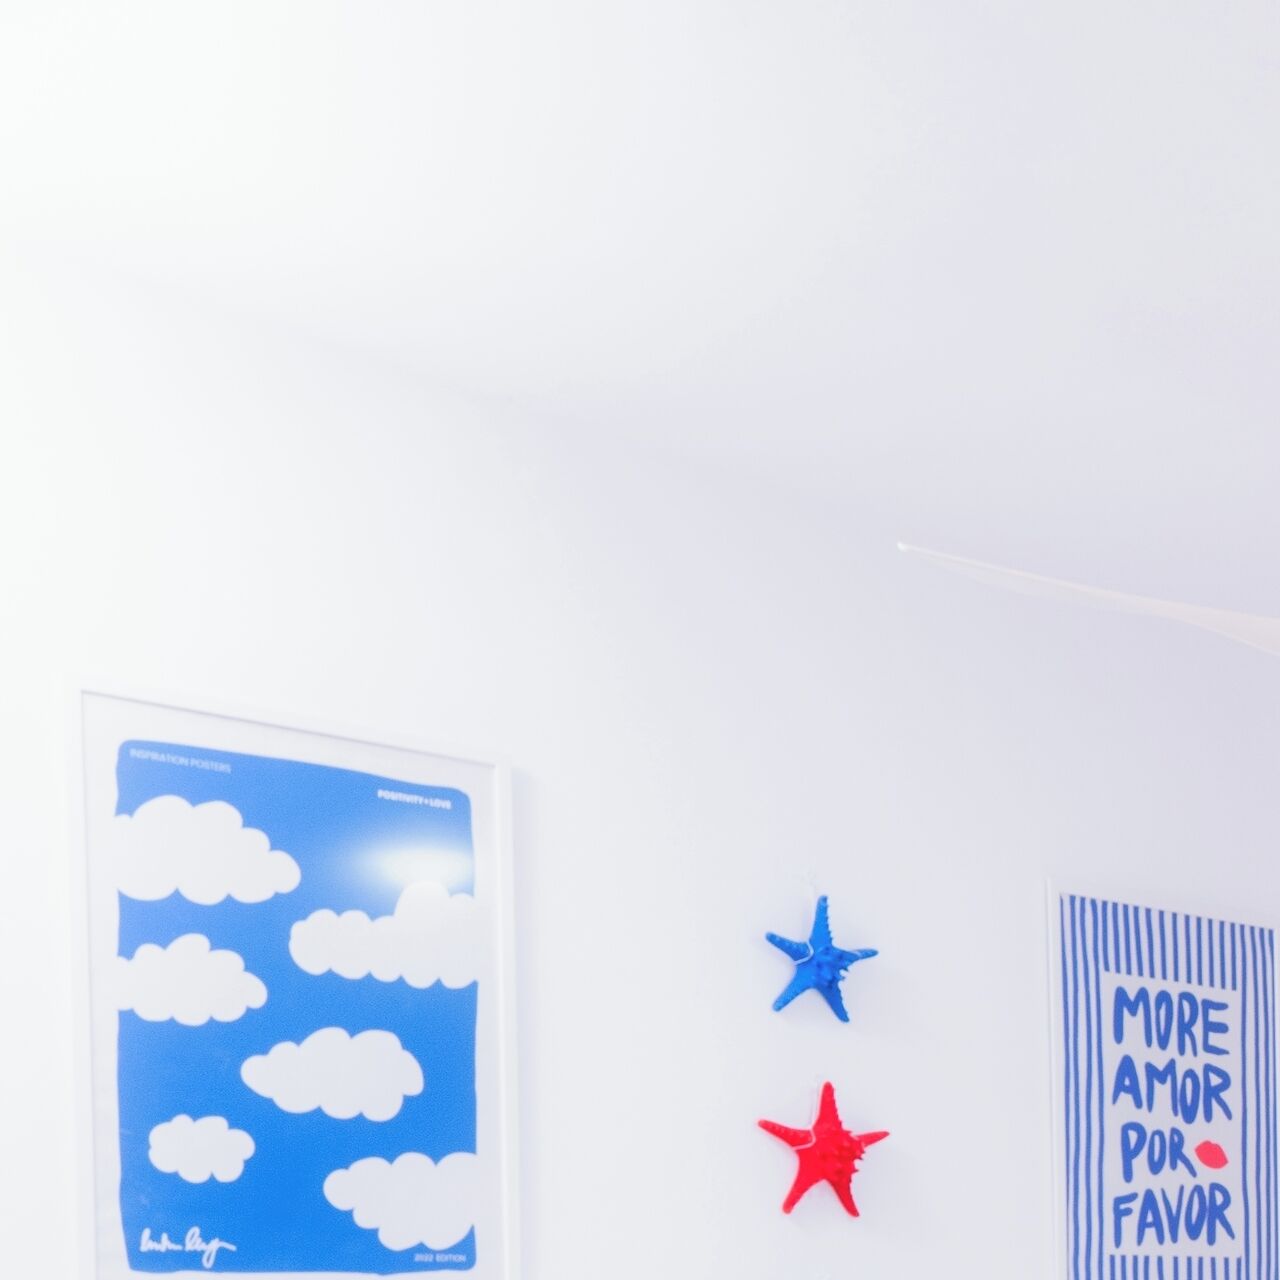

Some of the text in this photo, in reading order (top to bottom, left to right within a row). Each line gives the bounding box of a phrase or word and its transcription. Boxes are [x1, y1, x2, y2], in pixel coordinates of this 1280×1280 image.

[190, 758, 232, 774] POSTERS
[1113, 986, 1230, 1057] MORE
[1112, 1055, 1234, 1124] AMOR
[1121, 1121, 1198, 1184] POR
[1112, 1182, 1236, 1249] FAVOR
